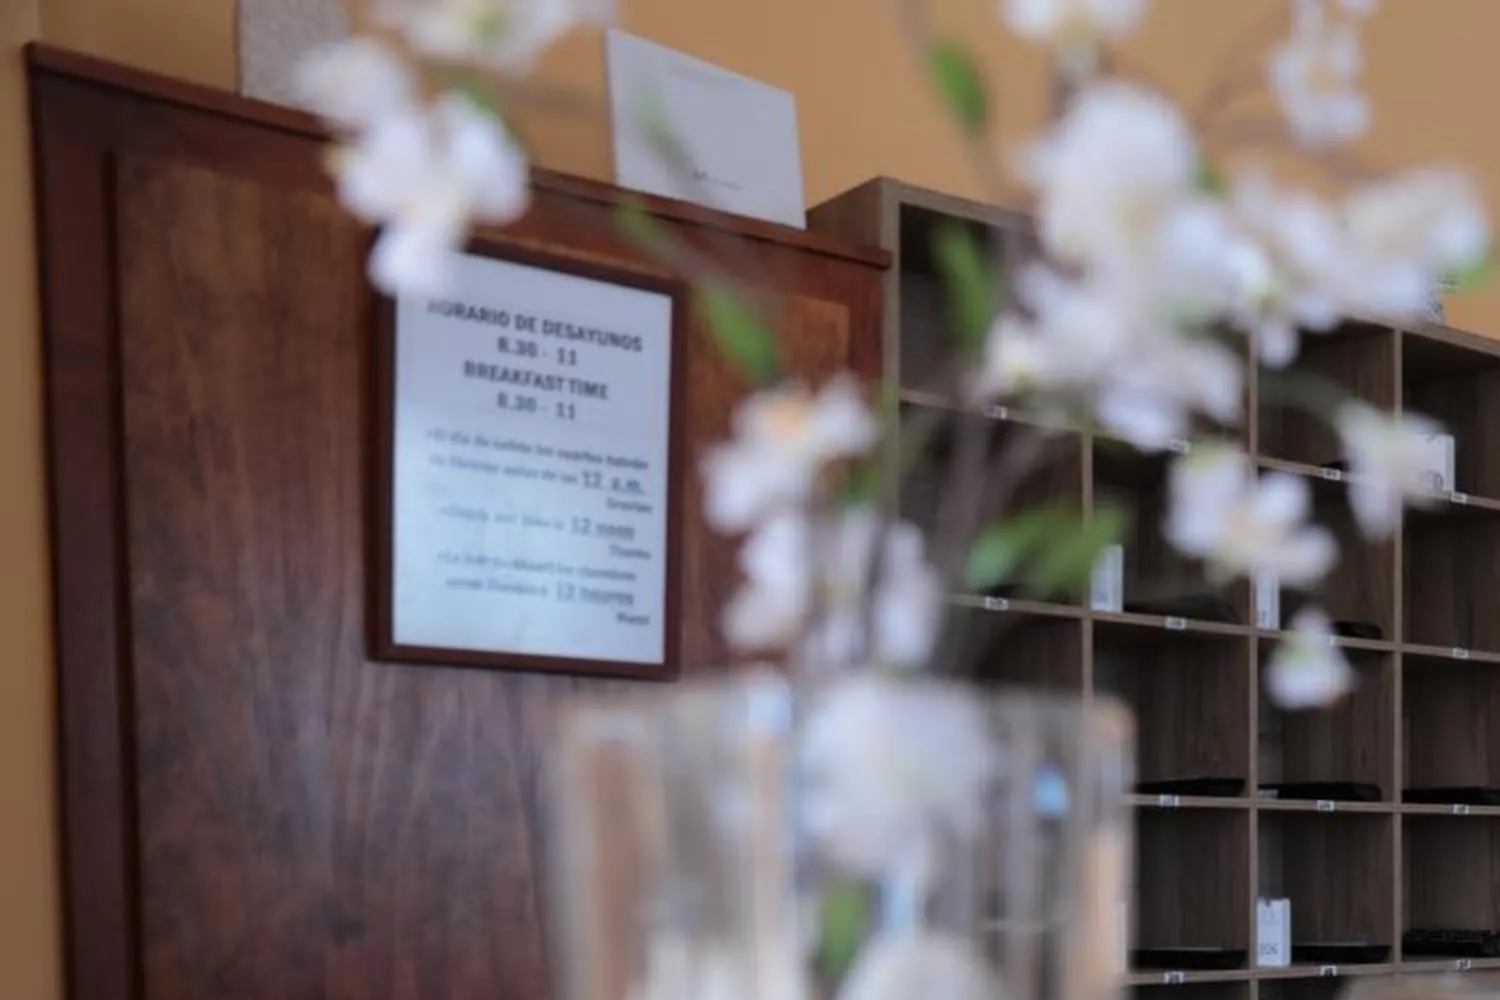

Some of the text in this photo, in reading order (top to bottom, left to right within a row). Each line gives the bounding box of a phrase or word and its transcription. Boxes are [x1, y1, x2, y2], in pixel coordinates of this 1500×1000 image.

[515, 314, 537, 333] DE
[542, 319, 643, 352] DESAYUNOS
[557, 347, 577, 366] 11
[463, 360, 609, 400] BREAKFAST TIME
[556, 401, 576, 421] 11
